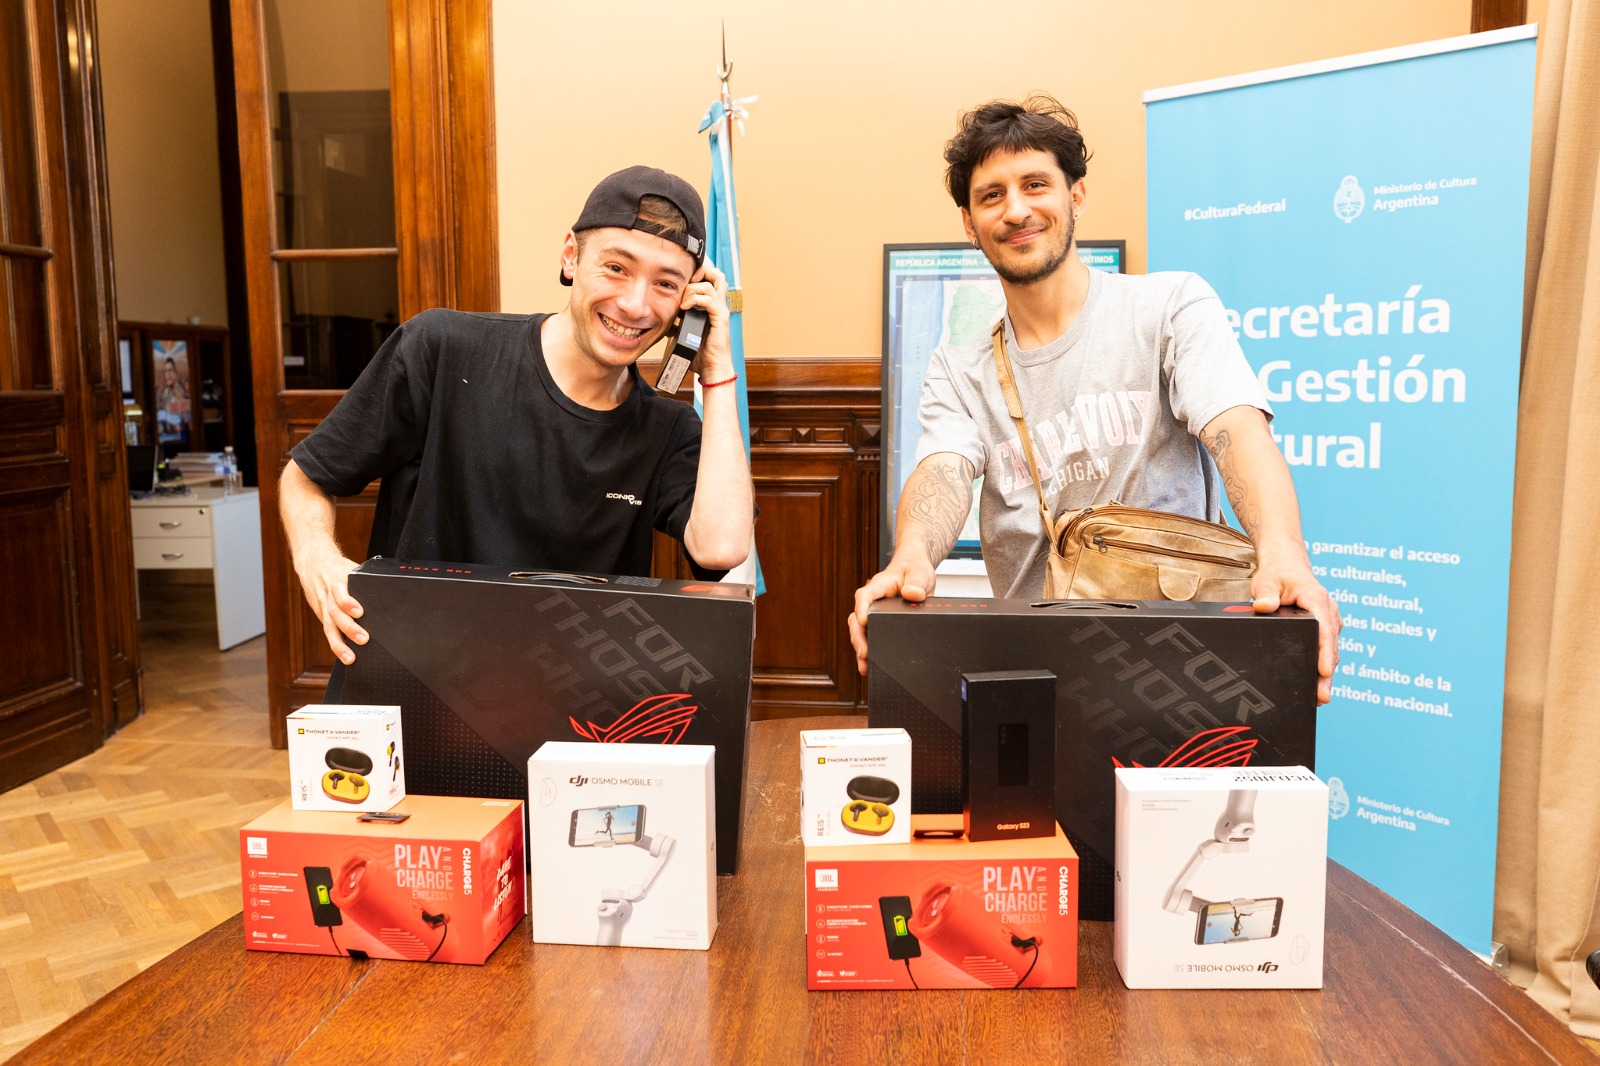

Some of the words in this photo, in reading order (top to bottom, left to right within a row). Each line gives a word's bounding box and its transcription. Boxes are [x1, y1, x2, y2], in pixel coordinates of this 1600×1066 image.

[1373, 181, 1423, 195] Ministerio
[1423, 179, 1438, 191] de
[1439, 176, 1477, 189] Cultura
[1184, 198, 1286, 221] #CulturaFederal
[1373, 194, 1439, 212] Argentina
[937, 258, 978, 266] ARGENTINA
[1225, 284, 1451, 340] ecretaría
[1257, 353, 1467, 403] Gestión
[1047, 456, 1110, 495] CHIGAN
[1312, 541, 1386, 559] garantizar
[1389, 546, 1403, 560] el
[1407, 550, 1461, 565] acceso
[1312, 564, 1327, 576] os
[1330, 565, 1407, 587] culturales,
[1329, 588, 1358, 604] ción
[1361, 593, 1424, 614] cultural,
[1343, 614, 1368, 630] des
[1371, 617, 1423, 638] locales
[1426, 627, 1437, 641] y
[601, 597, 714, 692] FOR
[1366, 644, 1376, 657] y
[1144, 622, 1276, 724] FOR
[1342, 662, 1355, 675] el
[1358, 664, 1411, 685] ámbito
[1414, 673, 1433, 688] de
[1437, 676, 1452, 691] la
[1331, 686, 1381, 704] rritorio
[1384, 695, 1453, 718] nacional.
[591, 777, 618, 785] OSMO
[620, 778, 653, 787] MOBILE
[1356, 807, 1416, 832] Argentina
[1357, 795, 1402, 813] Ministerio
[1402, 807, 1415, 817] de
[1416, 810, 1450, 826] Cultura
[997, 823, 1020, 831] Galaxy
[394, 843, 443, 870] PLAY
[442, 846, 452, 871] AND
[396, 869, 454, 890] CHARGE
[462, 847, 473, 895] CHARGE5
[983, 866, 1037, 892] PLAY
[1036, 866, 1047, 892] AND
[412, 889, 454, 901] ENDLESSLY
[984, 891, 1048, 913] CHARGE
[1059, 866, 1068, 916] CHARGE5
[1001, 912, 1048, 924] ENDLESSLY
[1187, 964, 1223, 973] MOBILE
[1225, 964, 1254, 972] OSMO
